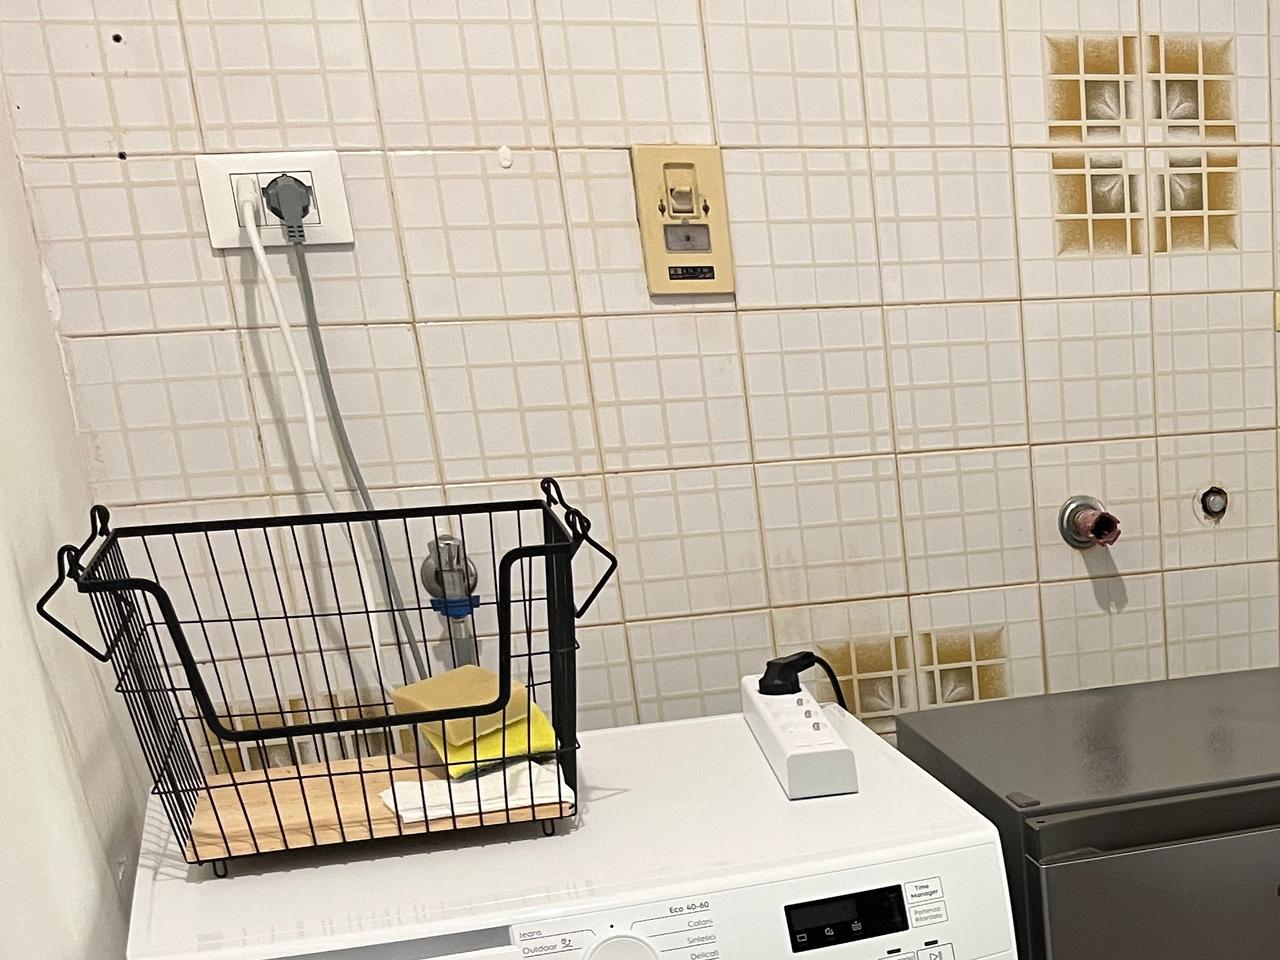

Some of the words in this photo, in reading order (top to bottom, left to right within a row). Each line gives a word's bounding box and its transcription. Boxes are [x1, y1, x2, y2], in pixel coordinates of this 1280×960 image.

[911, 889, 939, 899] Manager
[669, 906, 684, 914] Eco
[687, 901, 710, 911] 40-60
[522, 944, 557, 955] Outdoor
